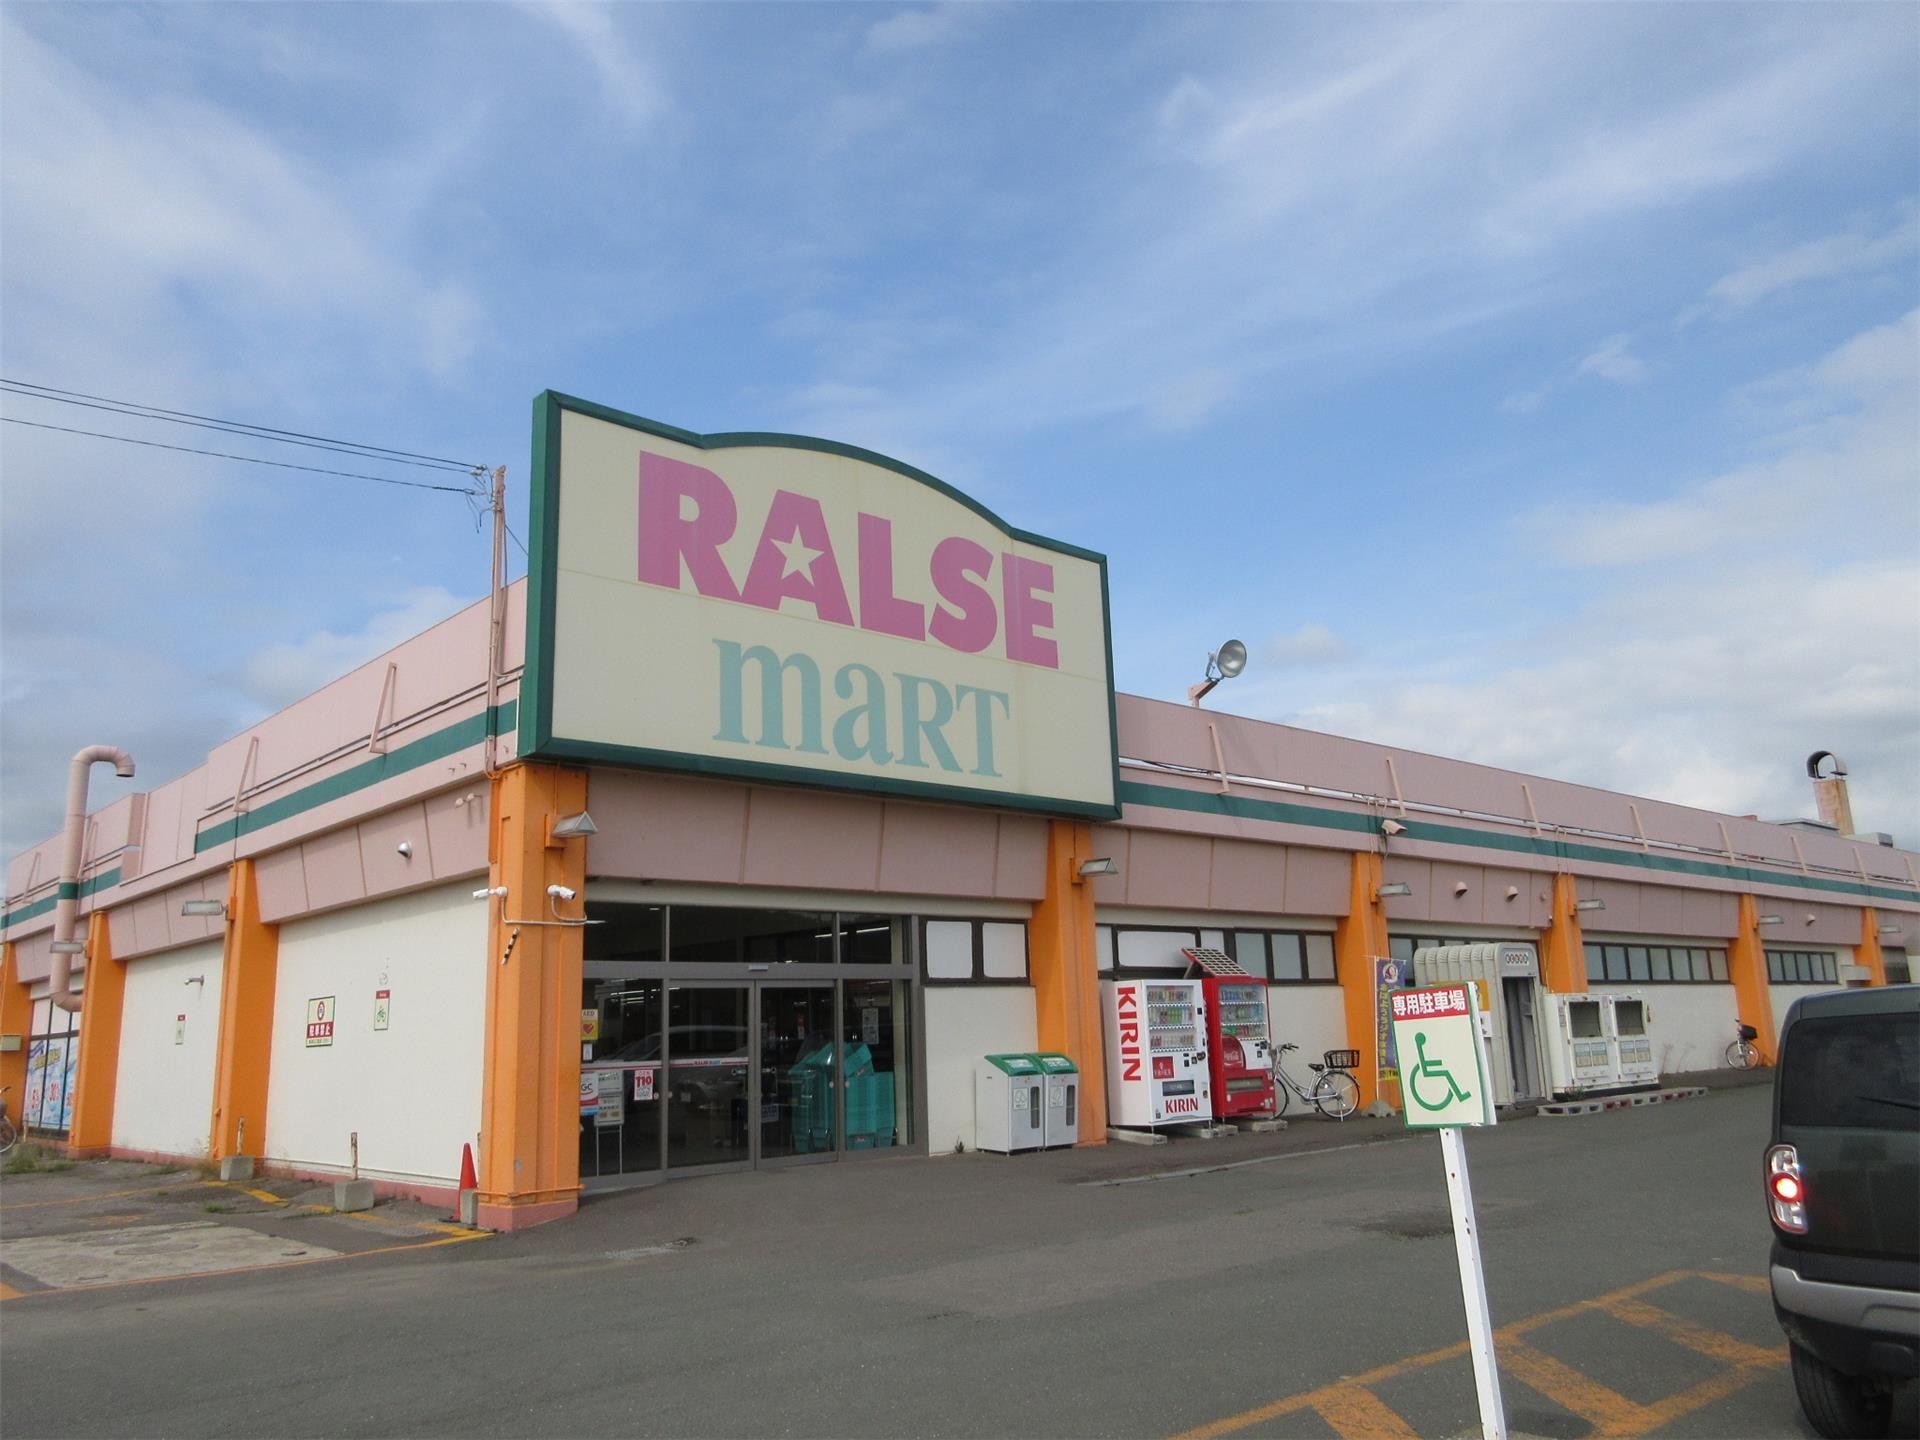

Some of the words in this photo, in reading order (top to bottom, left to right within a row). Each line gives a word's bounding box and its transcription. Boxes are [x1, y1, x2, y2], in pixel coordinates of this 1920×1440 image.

[638, 450, 1059, 669] RALSE
[1391, 989, 1466, 1016] 専用駐車場
[1117, 986, 1142, 1081] KIRIN
[635, 1075, 652, 1088] 110
[1165, 1098, 1199, 1114] KIRIN
